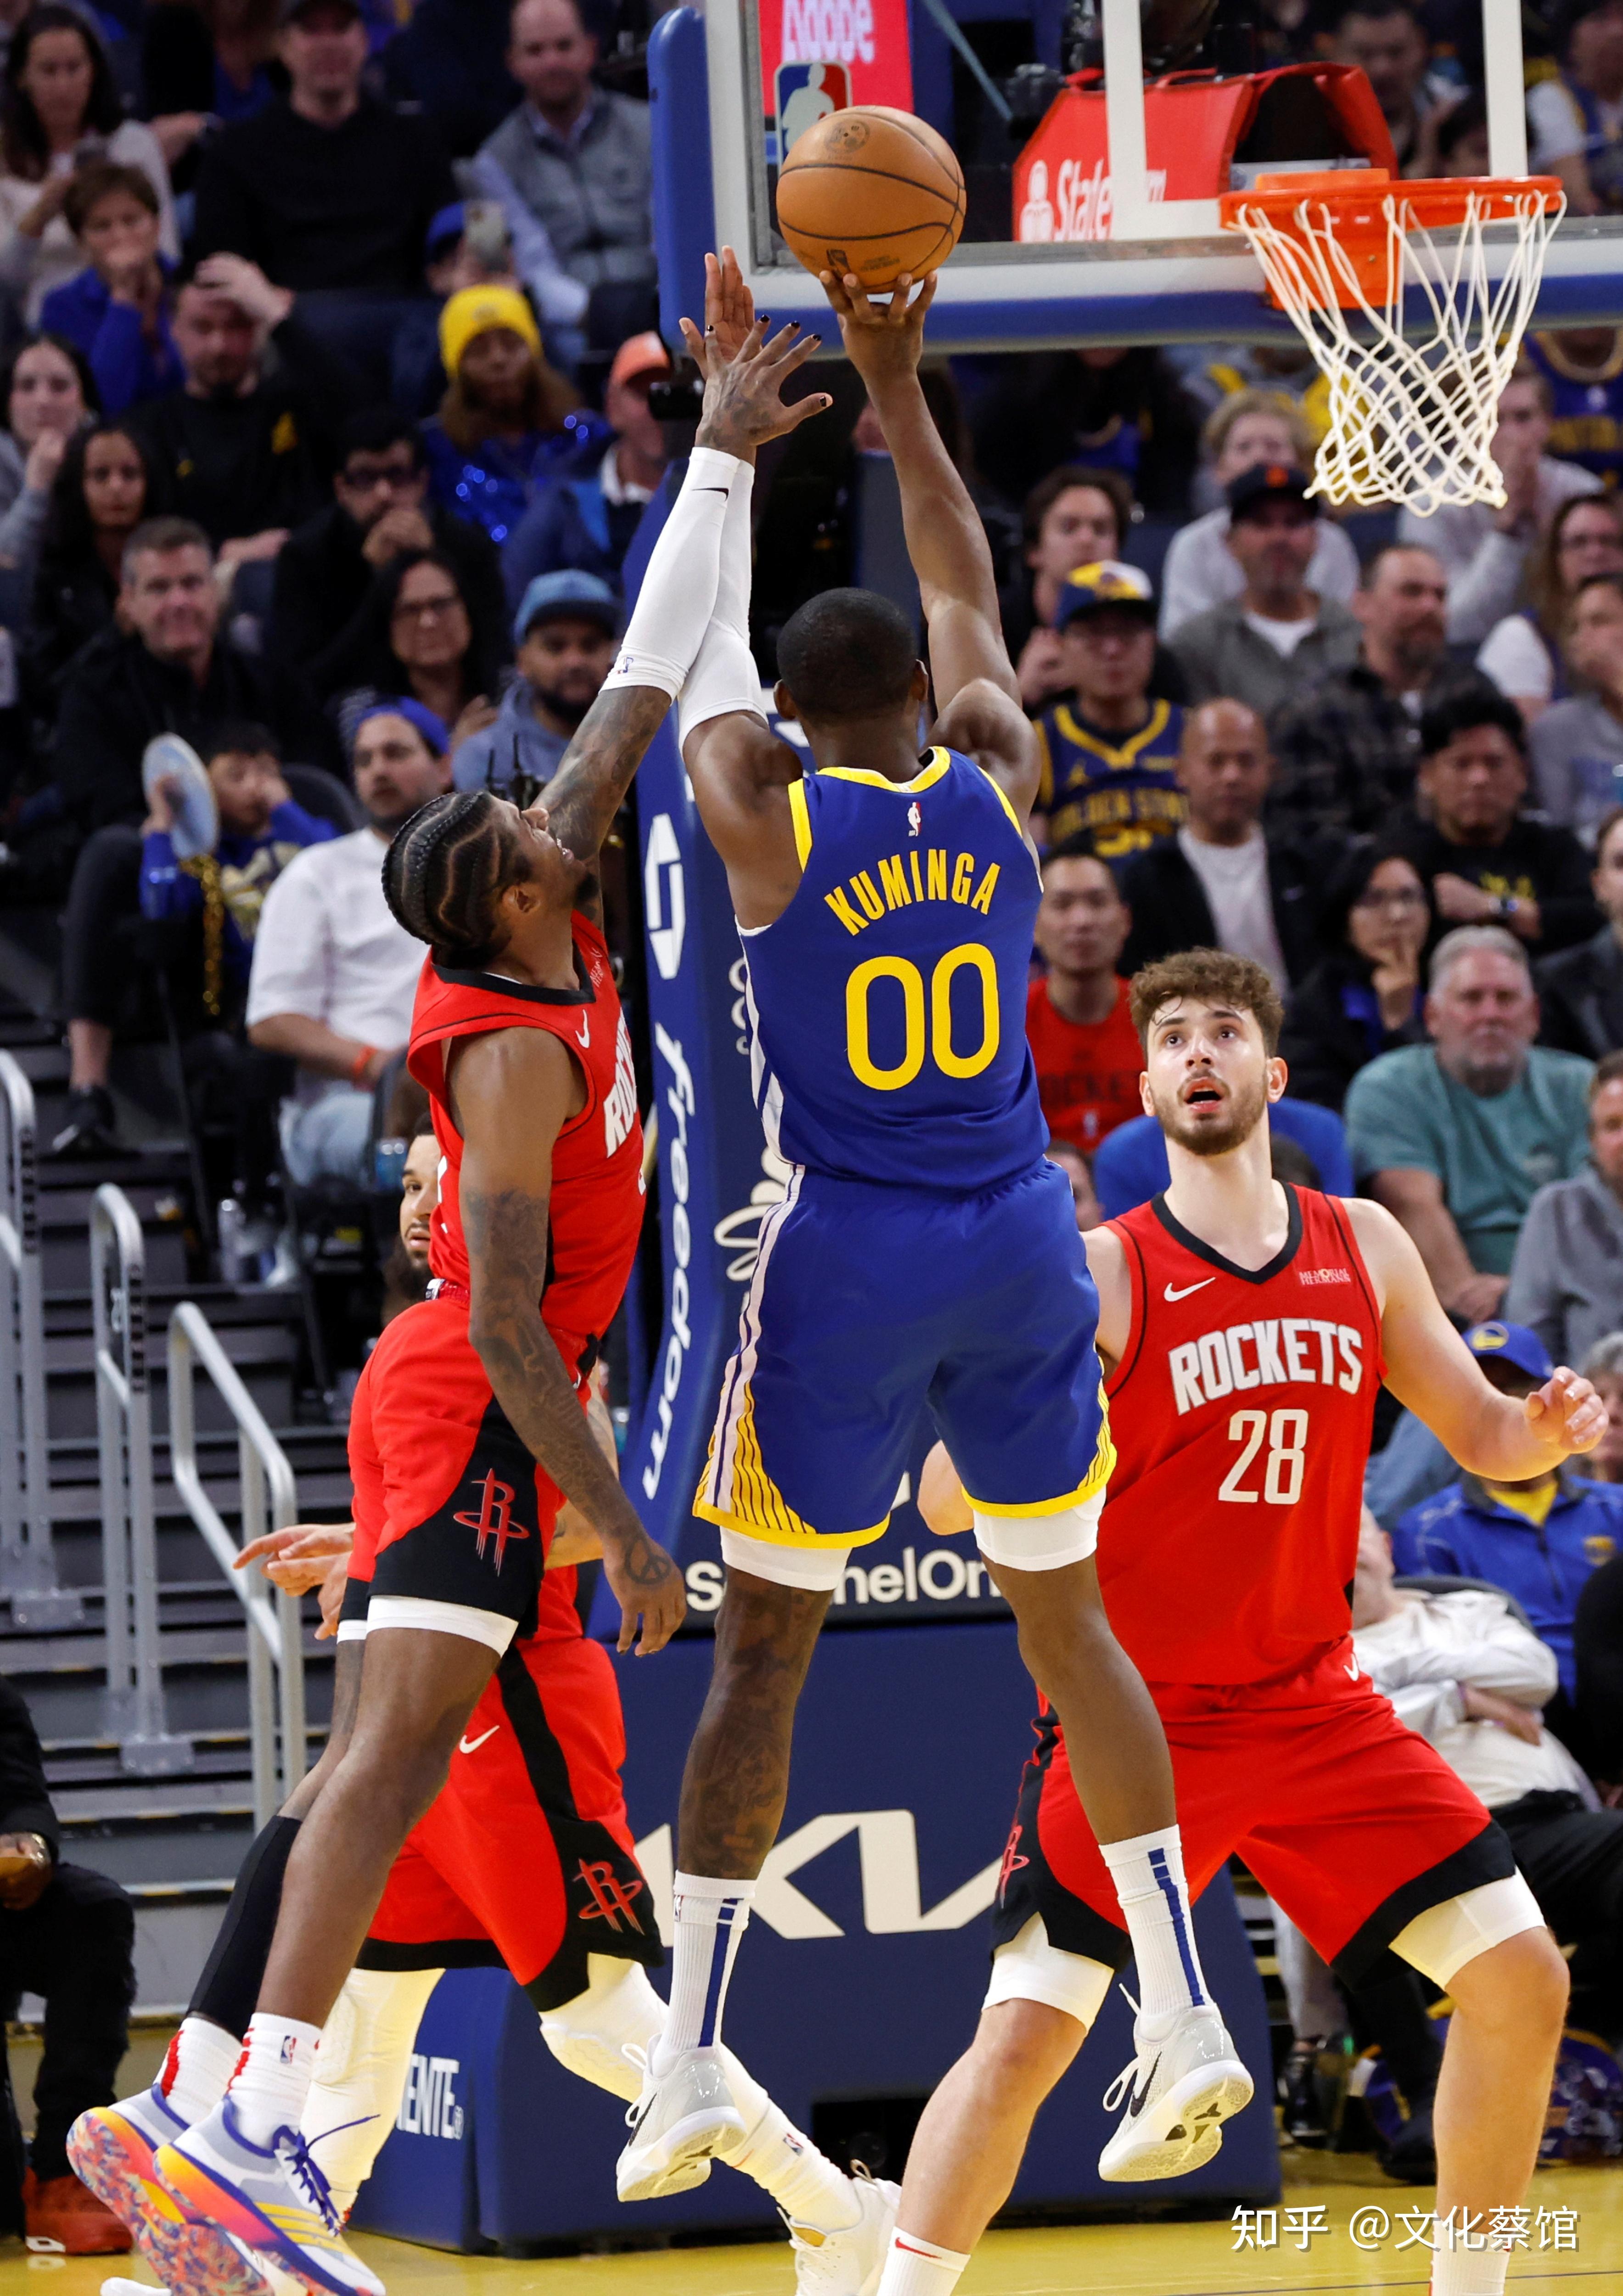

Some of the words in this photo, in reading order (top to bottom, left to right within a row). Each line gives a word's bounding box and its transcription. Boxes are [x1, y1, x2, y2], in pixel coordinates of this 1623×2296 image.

[824, 849, 1001, 936] KUMINGA
[846, 943, 1000, 1090] 00
[642, 1022, 695, 1500] freedom
[1168, 1318, 1363, 1416] ROCKETS
[1218, 1409, 1309, 1504] 28
